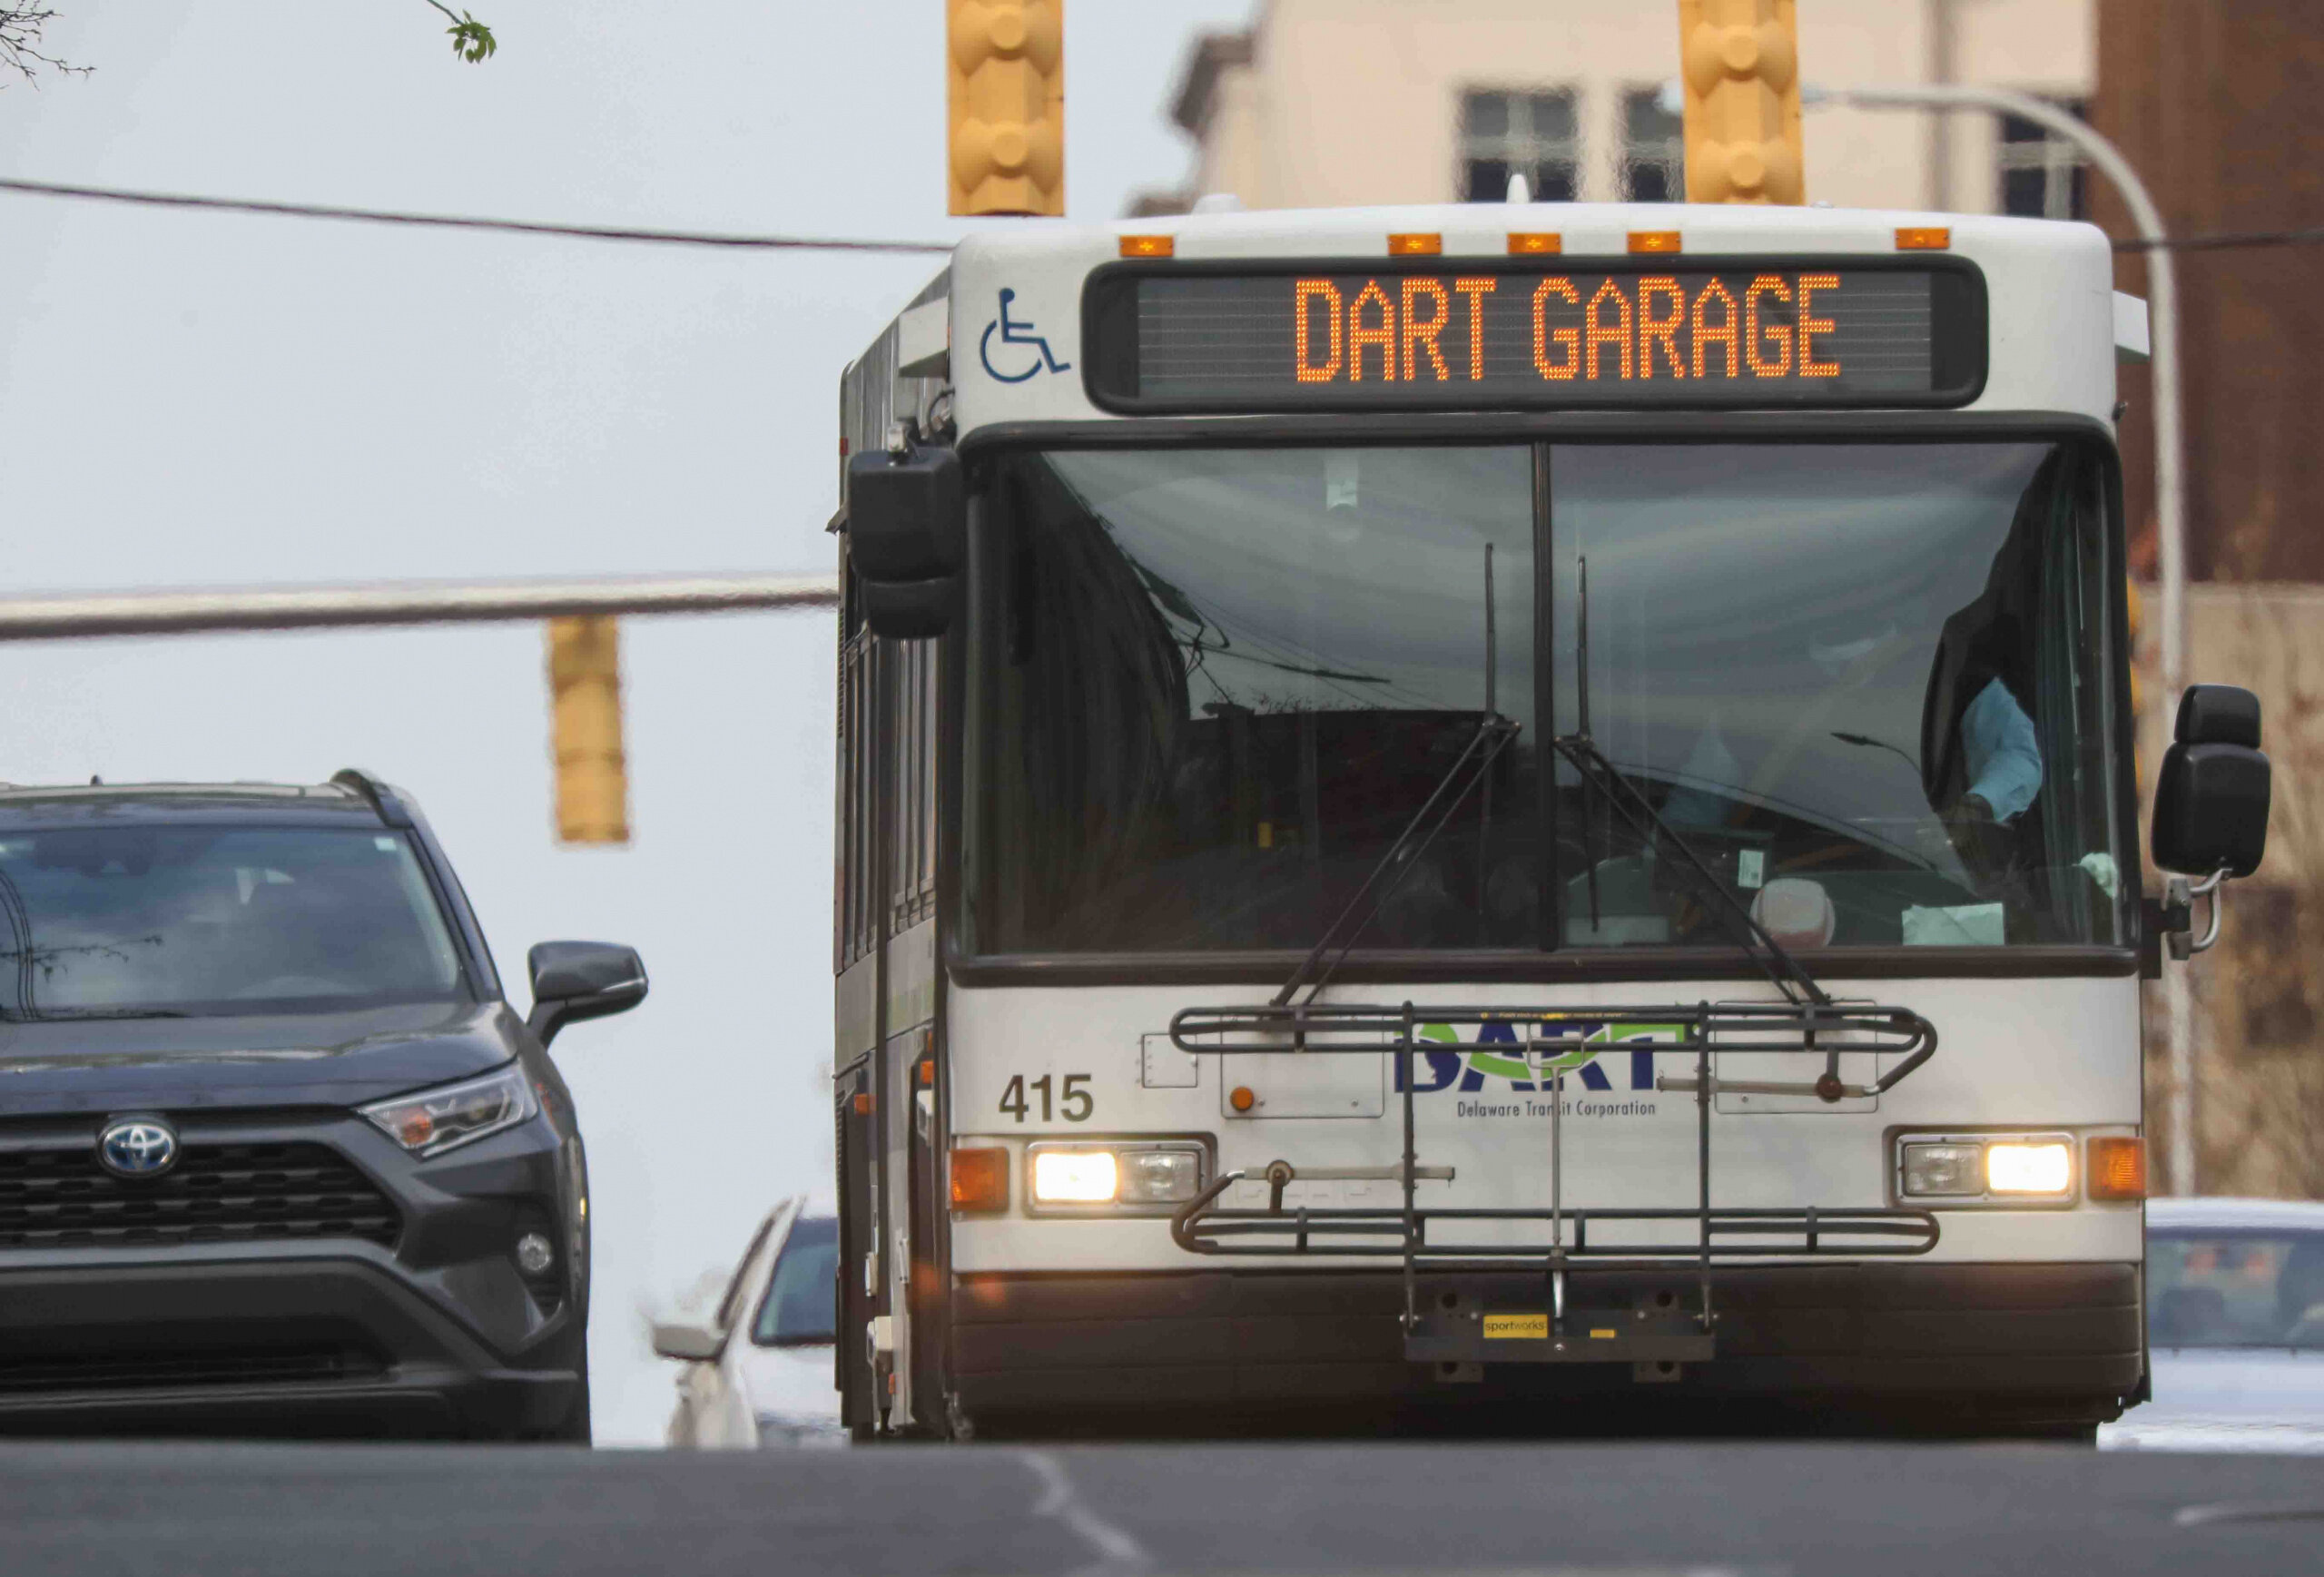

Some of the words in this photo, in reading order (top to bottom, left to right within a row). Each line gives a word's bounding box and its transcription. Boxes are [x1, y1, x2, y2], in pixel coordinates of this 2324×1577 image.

[1296, 277, 1498, 381] DART
[1531, 275, 1841, 379] GARAGE
[1393, 1013, 1687, 1092] DART
[999, 1073, 1094, 1123] 415
[1457, 1100, 1520, 1118] Delaware
[1526, 1099, 1571, 1117] Tranit
[1576, 1099, 1657, 1118] Corporation
[1484, 1320, 1546, 1332] sportworks
